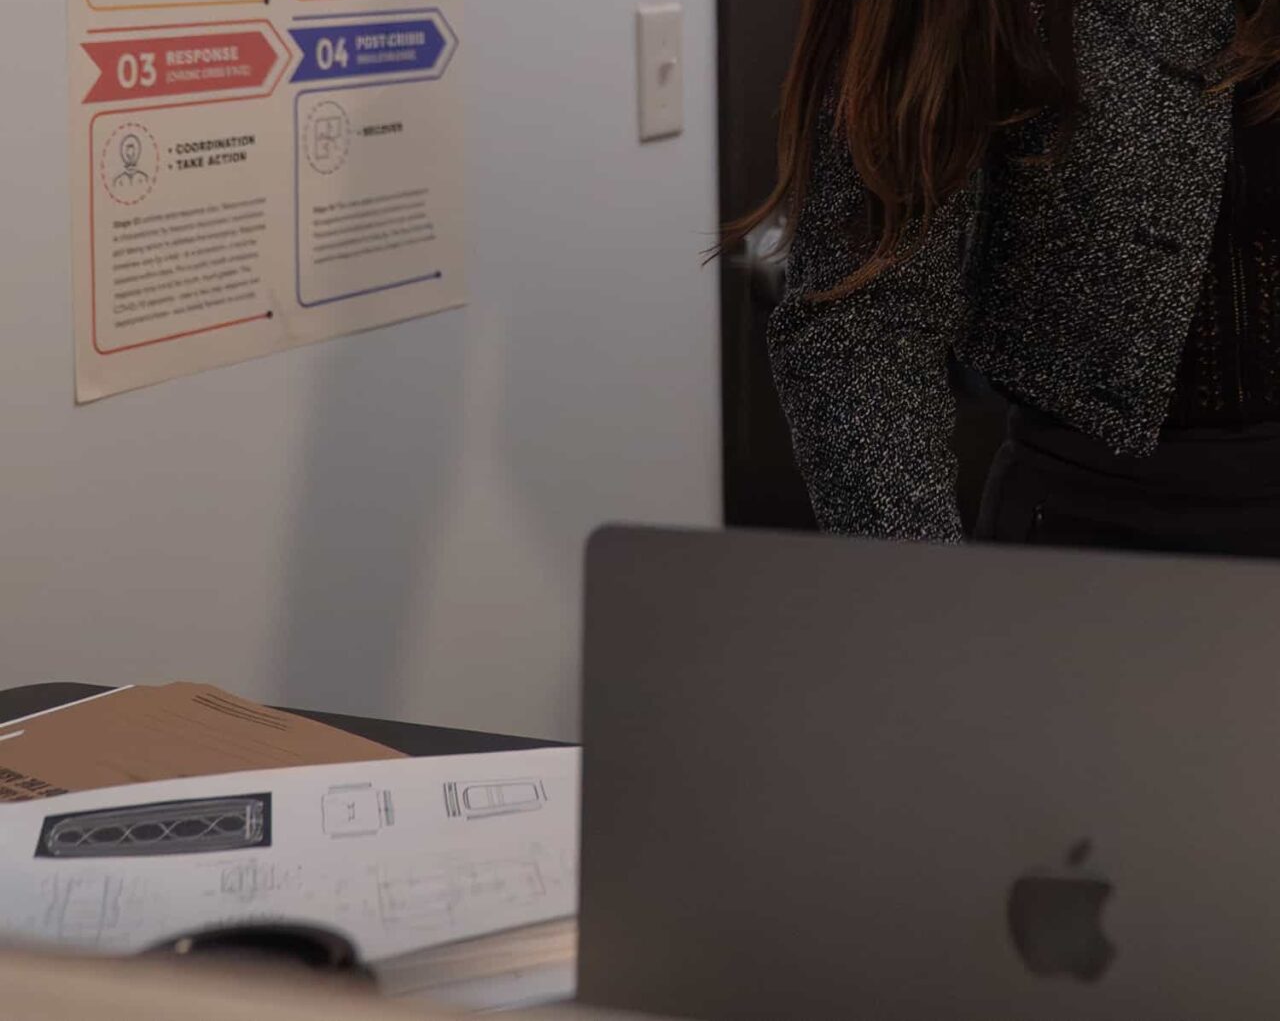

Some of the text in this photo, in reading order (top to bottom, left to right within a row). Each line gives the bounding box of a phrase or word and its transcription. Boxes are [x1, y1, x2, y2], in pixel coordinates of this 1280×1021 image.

[165, 46, 239, 66] RESPONSE
[316, 37, 349, 70] 04
[117, 51, 157, 89] 03
[175, 134, 256, 155] COORDINATION
[176, 151, 248, 171] TAKE ACTION
